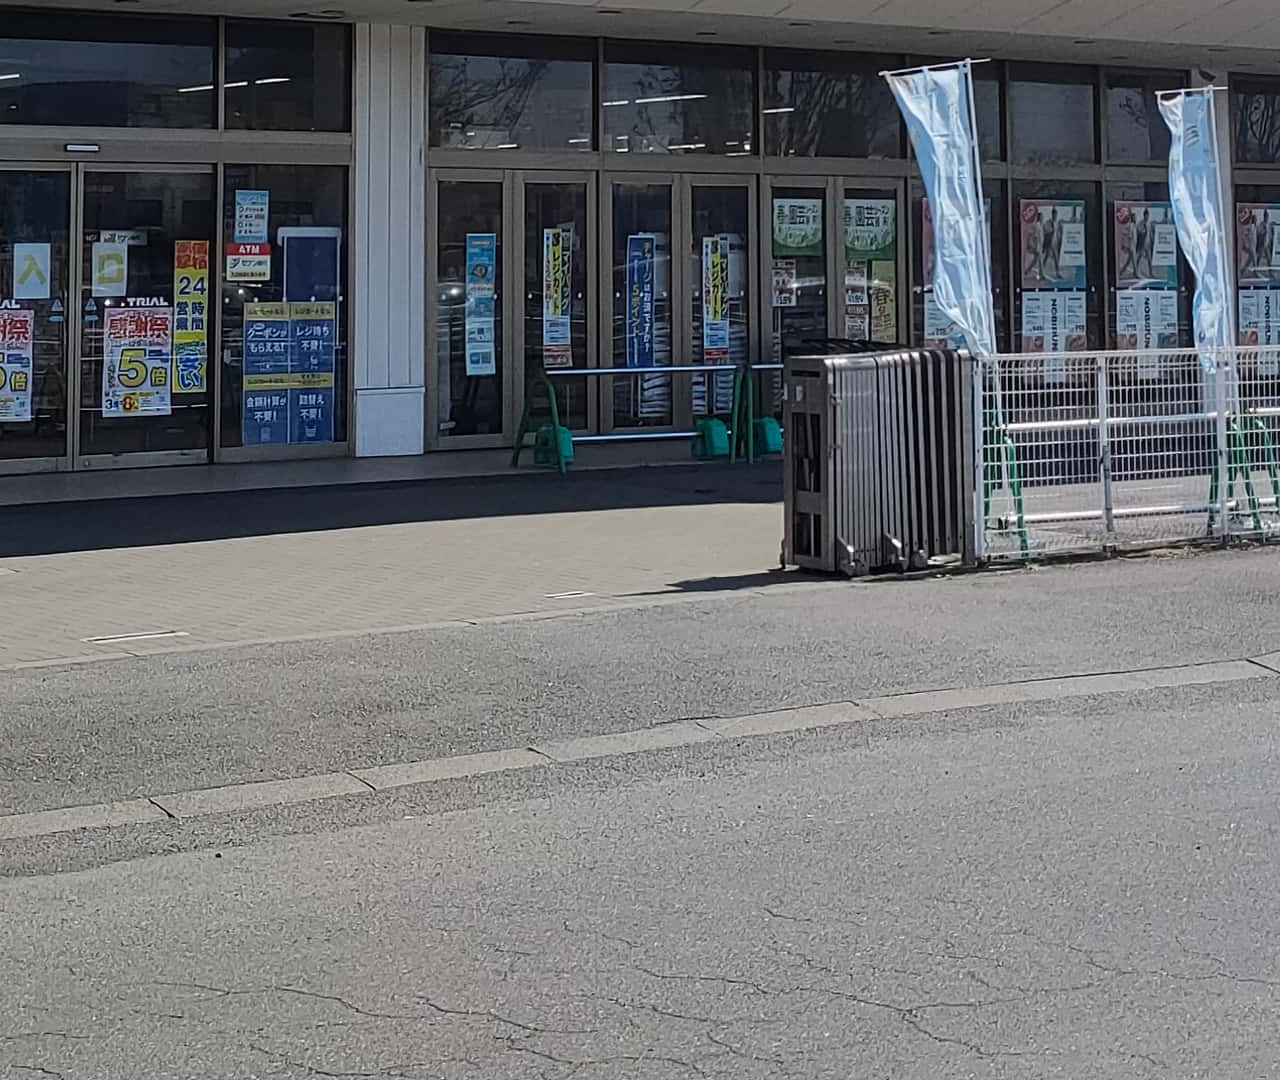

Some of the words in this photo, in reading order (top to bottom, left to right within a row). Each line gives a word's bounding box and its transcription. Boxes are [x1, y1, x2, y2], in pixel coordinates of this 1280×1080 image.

[238, 244, 260, 254] ATM
[178, 276, 207, 296] 24
[126, 297, 169, 307] TRIAL
[108, 315, 170, 339] 感謝祭
